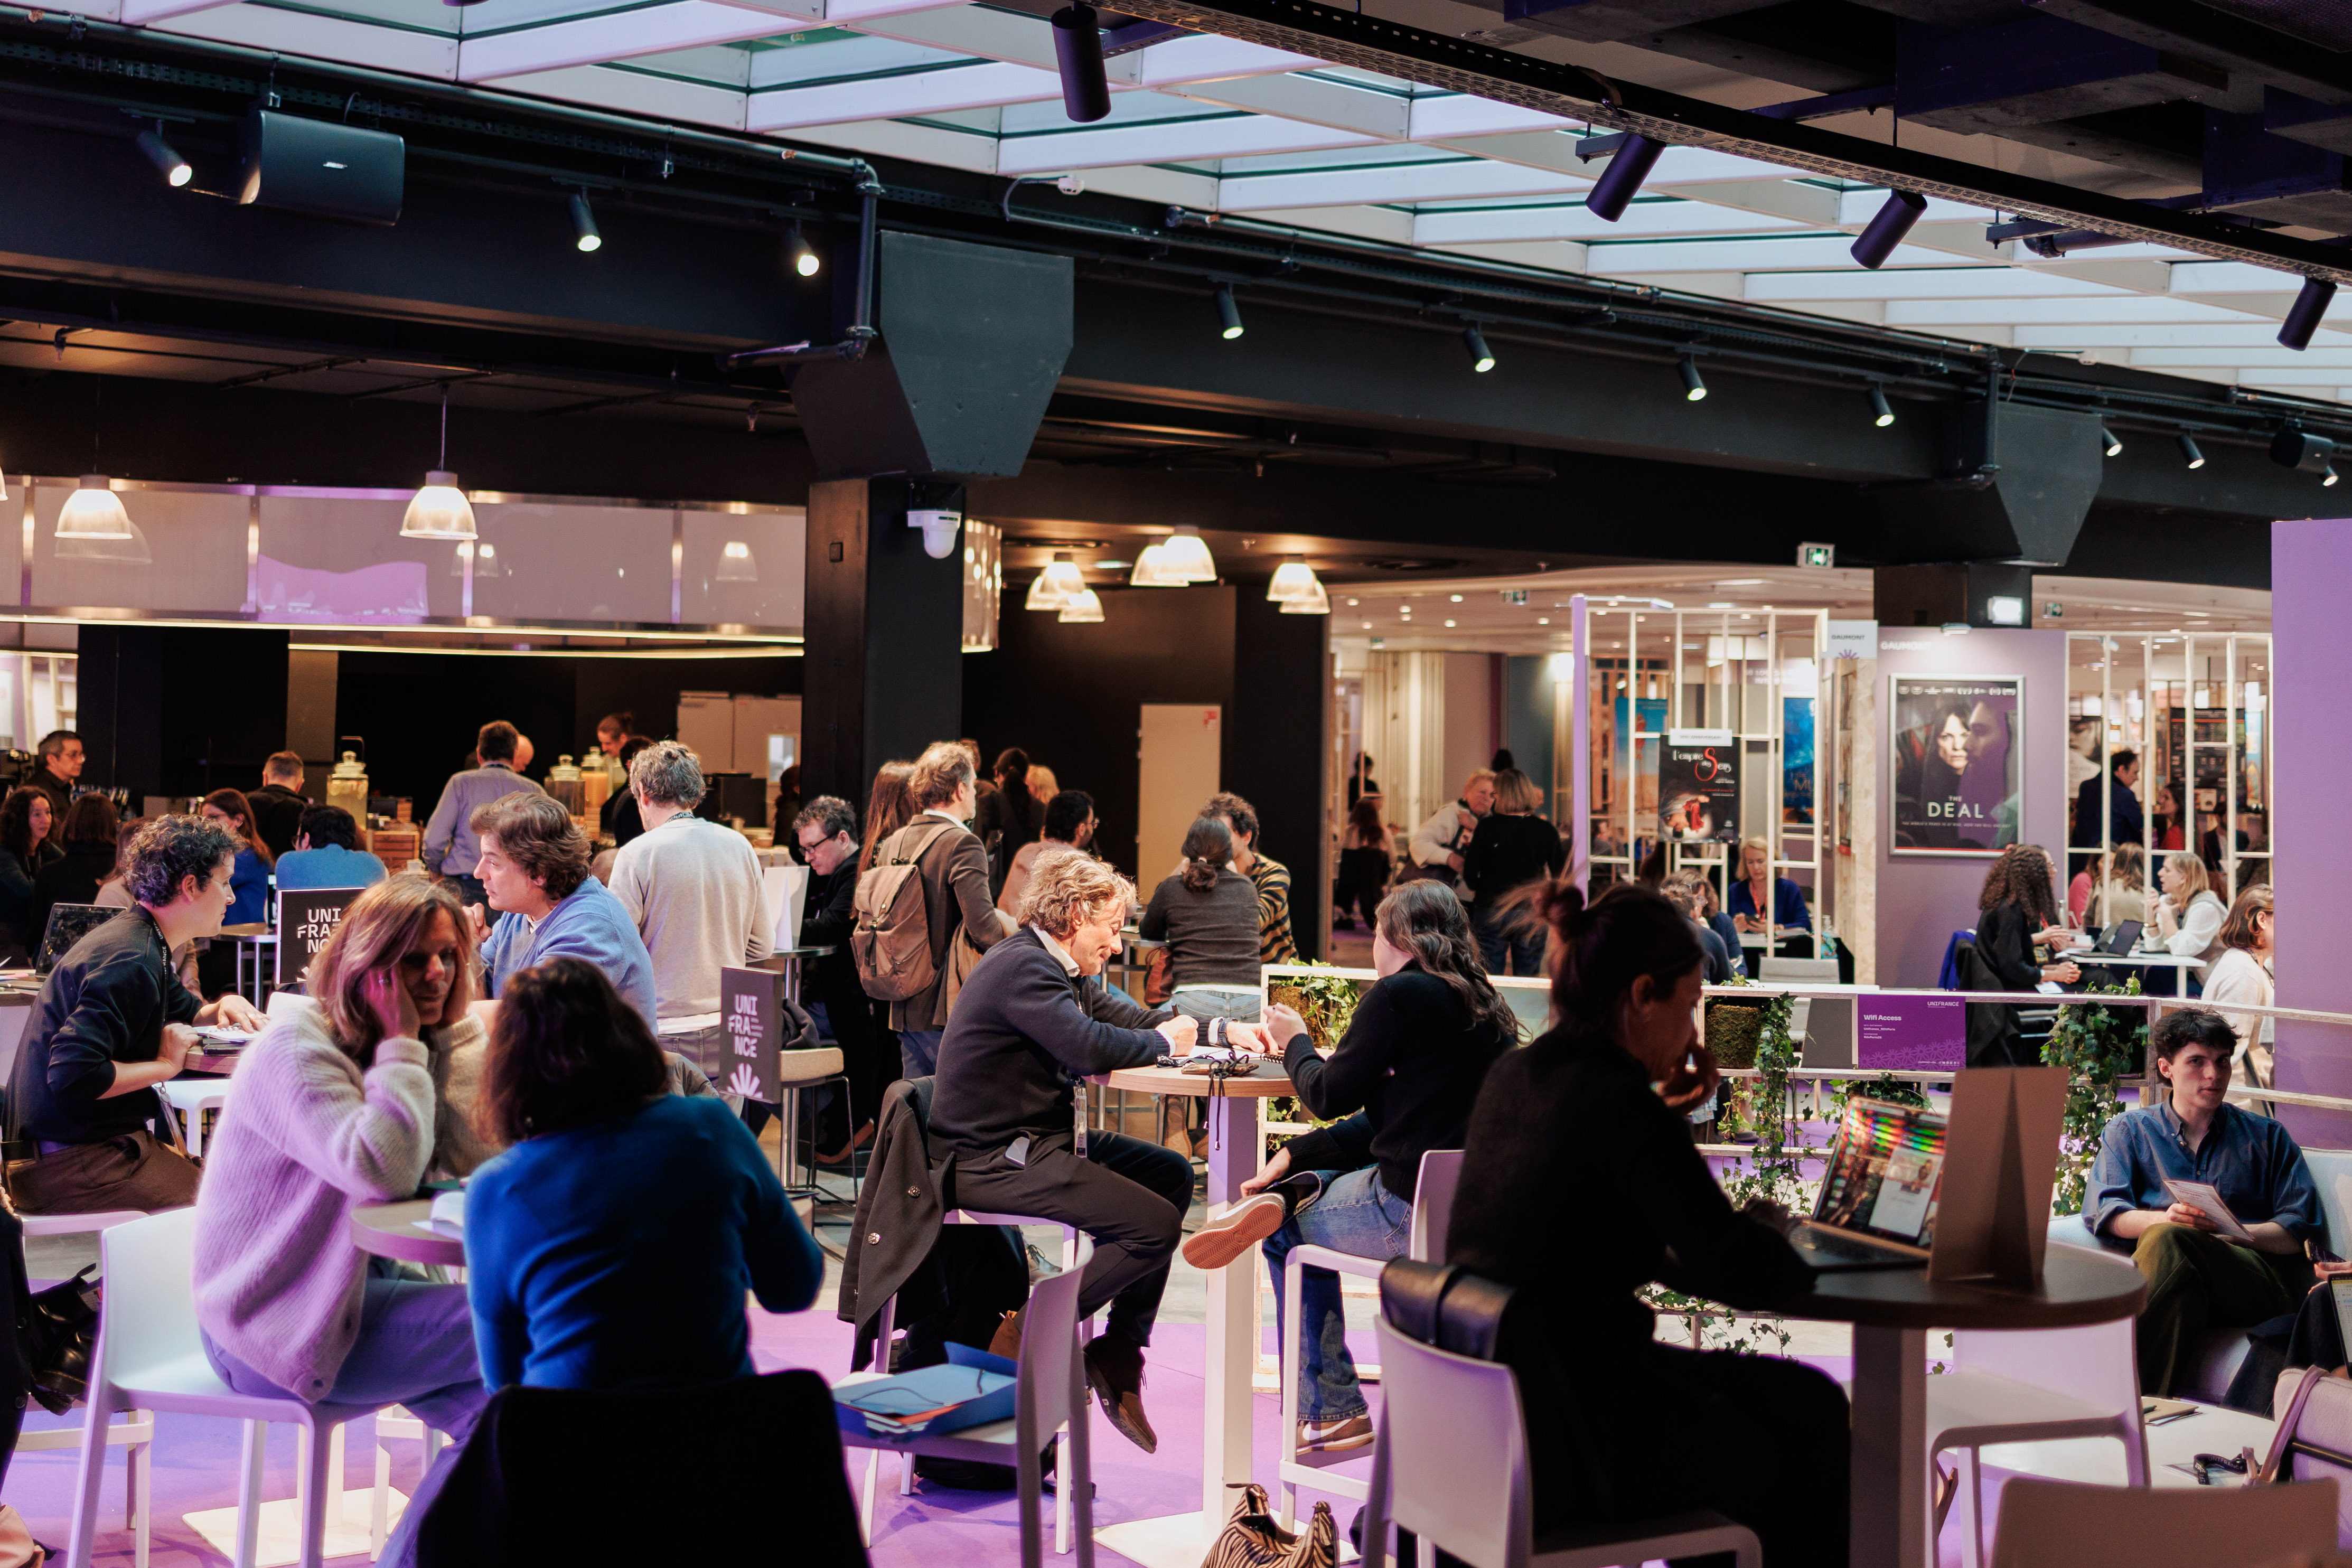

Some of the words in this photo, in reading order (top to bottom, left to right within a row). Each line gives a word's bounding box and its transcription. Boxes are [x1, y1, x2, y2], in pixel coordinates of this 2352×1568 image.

[1927, 802, 1984, 819] DEAL
[308, 908, 341, 923] UNI
[297, 923, 331, 938] FRA
[307, 938, 330, 953] NC
[735, 994, 758, 1016] UNI
[728, 1014, 752, 1036] FRA
[734, 1035, 757, 1058] NCE
